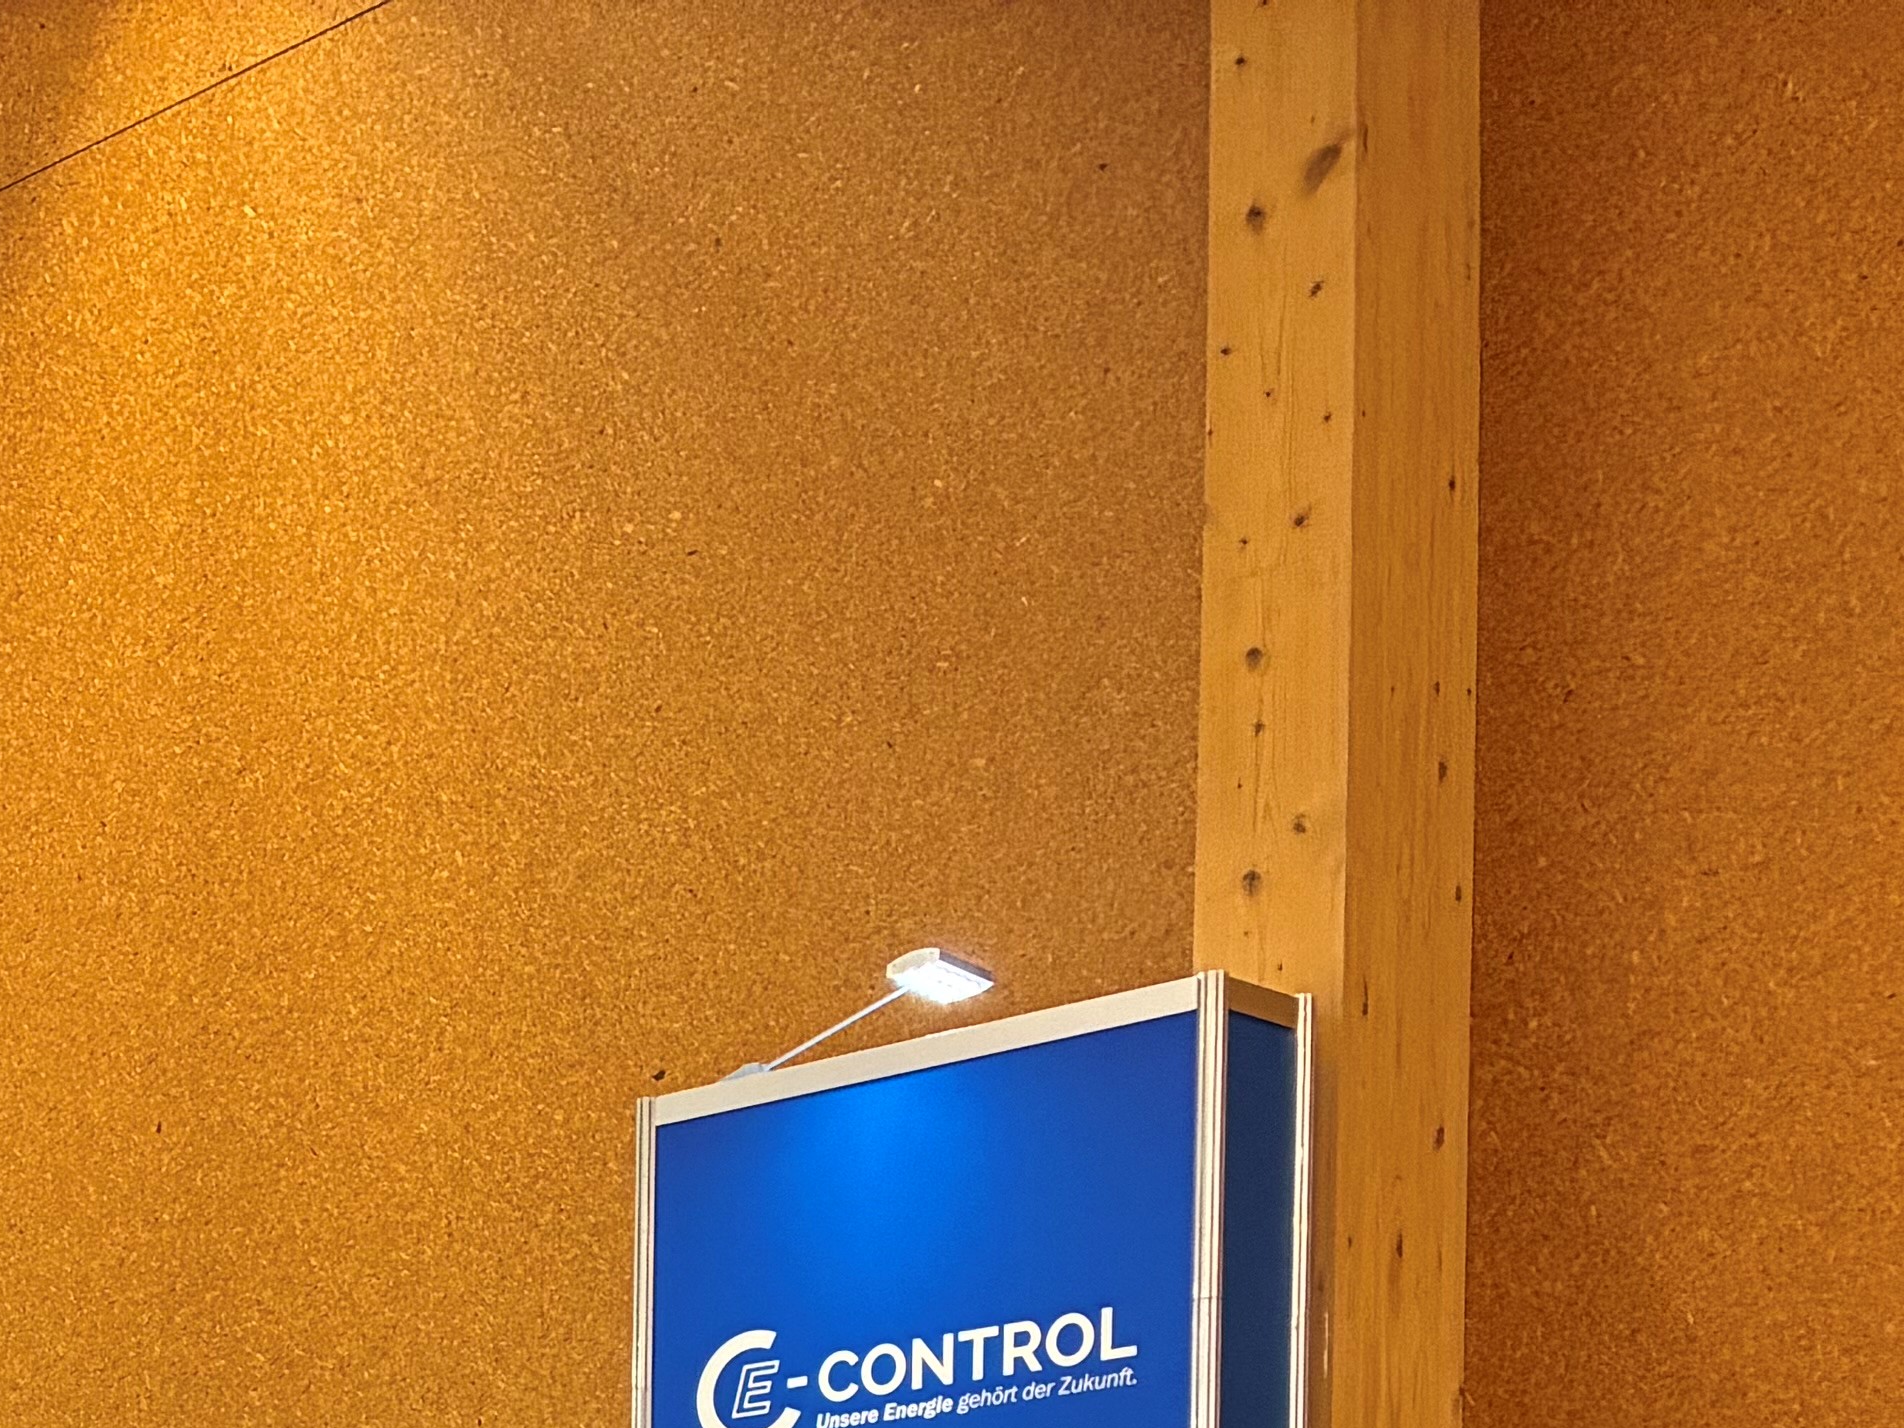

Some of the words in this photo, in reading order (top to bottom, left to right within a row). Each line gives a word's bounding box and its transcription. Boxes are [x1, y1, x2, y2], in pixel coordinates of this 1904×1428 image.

[883, 1395, 953, 1421] Energie
[956, 1386, 1018, 1414] gehört
[1022, 1382, 1056, 1401] der
[1058, 1367, 1137, 1395] Zukunft.
